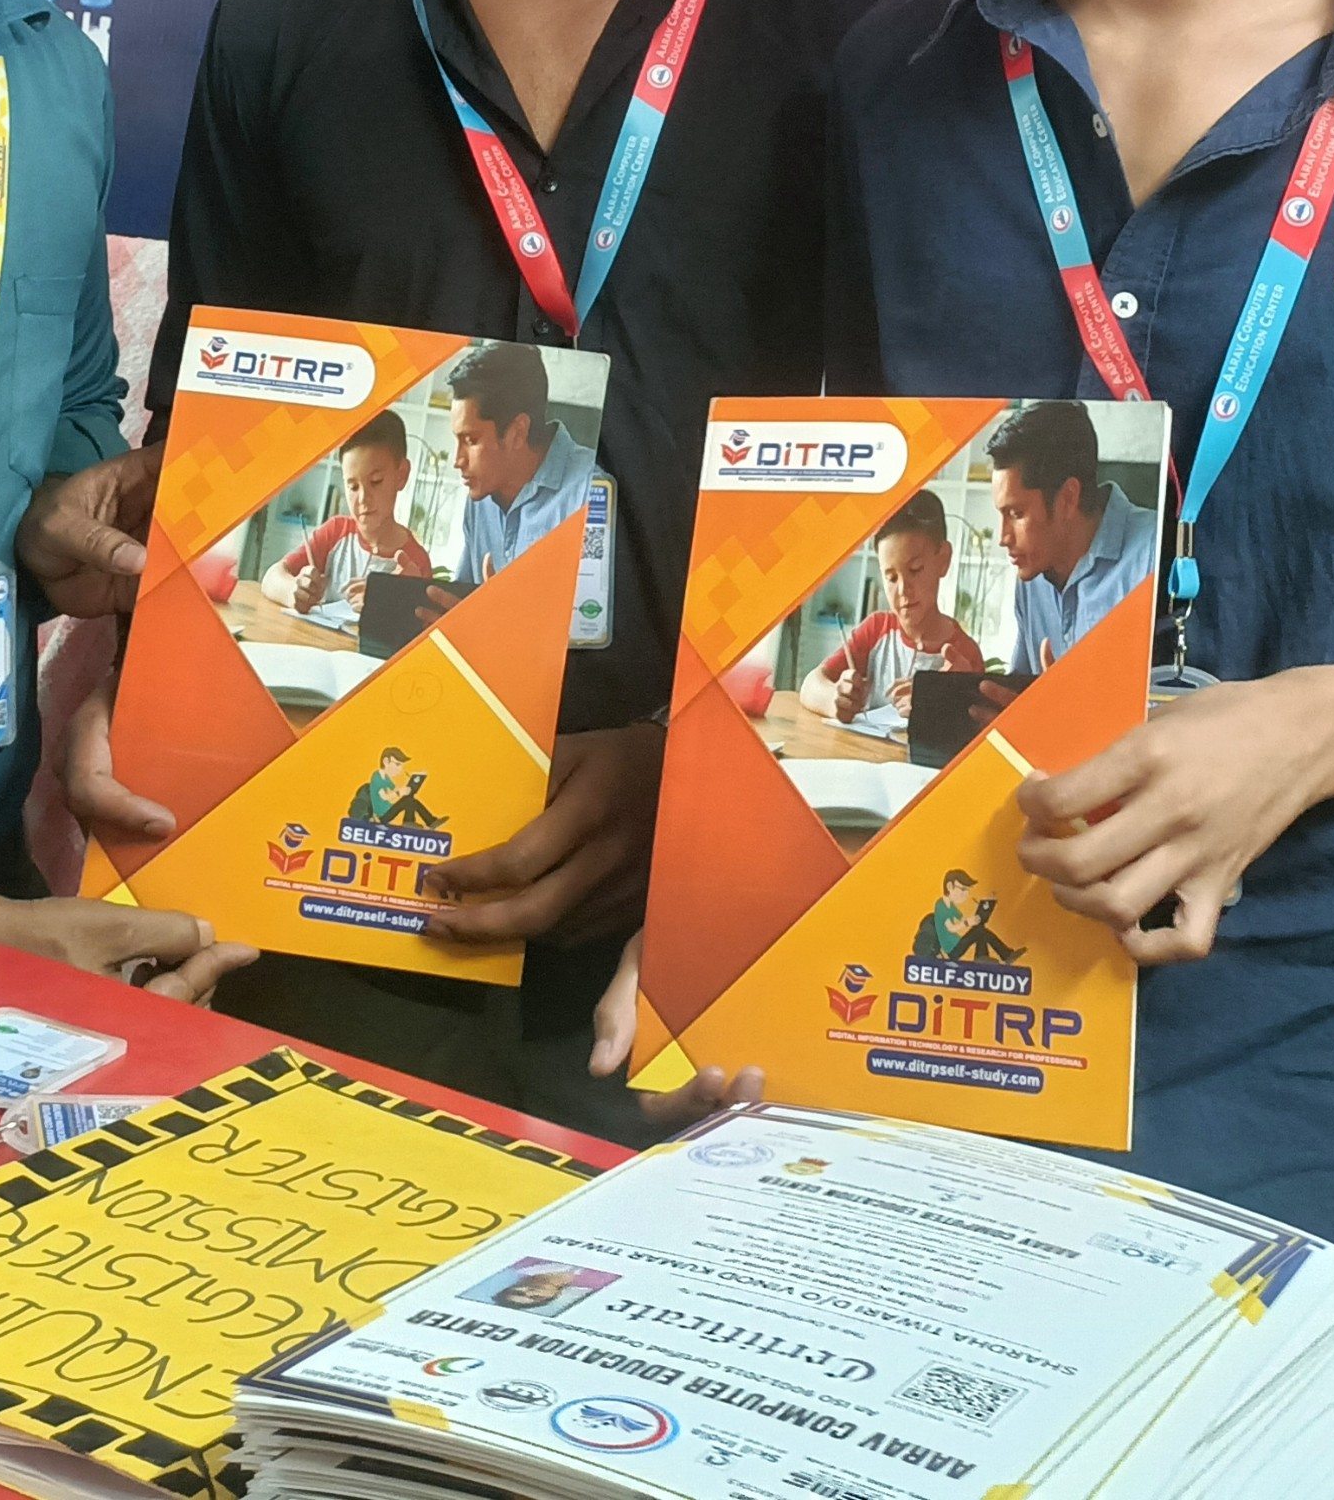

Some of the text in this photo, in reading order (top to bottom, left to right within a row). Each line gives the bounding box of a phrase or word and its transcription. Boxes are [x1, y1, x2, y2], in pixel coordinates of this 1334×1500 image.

[613, 136, 650, 226] EDUCATION CENTER
[1308, 146, 1334, 199] EDUCATION
[1223, 283, 1269, 383] AARAV COMPUTER
[1236, 284, 1285, 393] EDUCATION CENTER
[342, 826, 449, 854] SELF-STUDY
[321, 848, 438, 896] DiT
[303, 903, 425, 931] www.ditrpself-study
[908, 965, 1029, 993] SELF-STUDY
[828, 1031, 858, 1041] DIGITAL
[858, 1033, 907, 1046] INFORMATION
[908, 1039, 958, 1052] TECHNOLOGY
[967, 1046, 1007, 1058] RESEARCH
[1008, 1051, 1023, 1060] FOR
[1025, 1053, 1083, 1068] PROFESSIONAL
[872, 1057, 1040, 1087] www.ditrpself-study.com
[189, 1124, 525, 1244] EGISTER
[65, 1170, 438, 1303] DMISSION
[627, 1251, 714, 1276] KUMAR
[718, 1271, 794, 1294] VINOD
[801, 1291, 852, 1310] D/O
[855, 1306, 944, 1336] TIWARI
[606, 1300, 876, 1382] Certificate
[953, 1332, 1078, 1376] SHARDHA
[406, 1310, 976, 1480] AARAV COMPUTER EDUCATION CENTER
